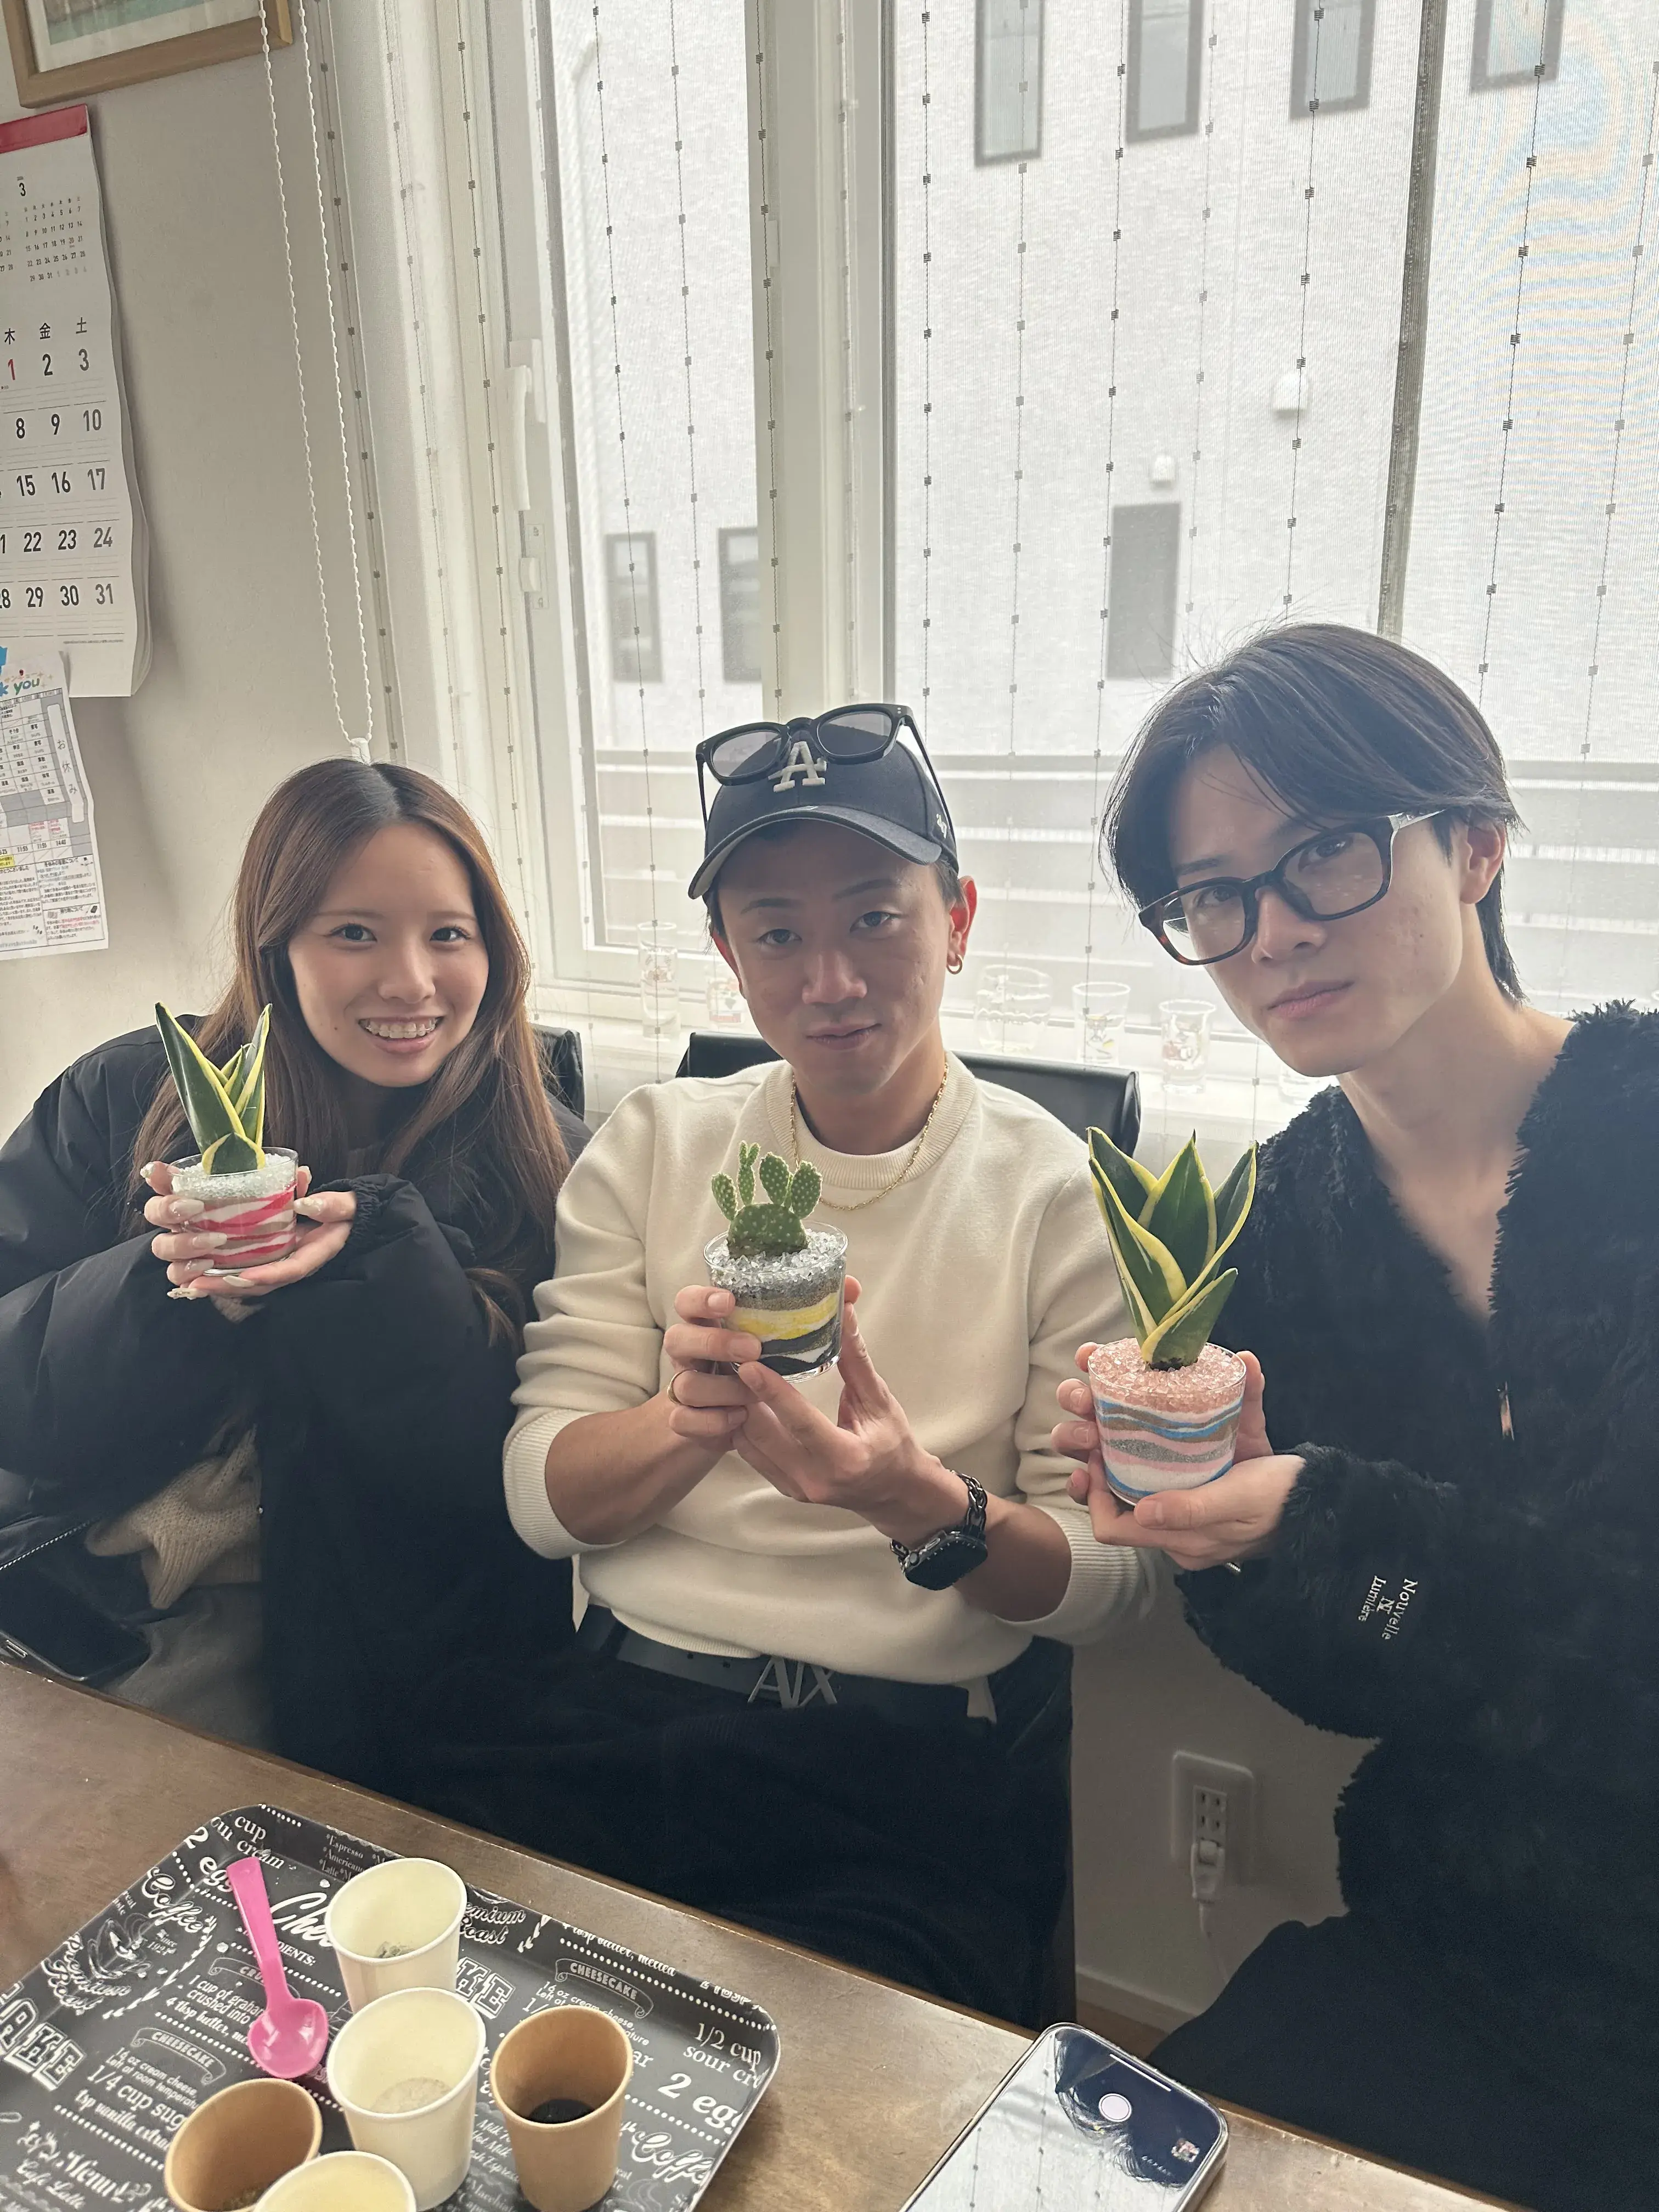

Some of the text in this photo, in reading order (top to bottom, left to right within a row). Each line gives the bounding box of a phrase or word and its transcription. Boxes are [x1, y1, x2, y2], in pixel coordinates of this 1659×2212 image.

[19, 183, 26, 196] 3
[4, 317, 87, 345] 木 金 土
[8, 349, 89, 380] 1 2 3
[16, 409, 101, 439] 8 9 10
[16, 468, 105, 496] 15 16 17
[0, 527, 113, 554] 1 22 23 24
[26, 587, 43, 607] 29
[60, 585, 80, 606] 30
[95, 584, 114, 605] 31
[14, 678, 40, 696] you
[1381, 1578, 1418, 1640] Nouvelle
[184, 1826, 209, 1849] 2
[234, 1816, 267, 1843] cup
[142, 1866, 204, 1933] Coffee
[465, 1902, 526, 1924] emium
[277, 1940, 317, 1966] DIENTS:
[188, 1974, 201, 1985] 1
[196, 1980, 218, 1994] cup
[216, 1989, 234, 2000] of
[543, 1981, 557, 1993] 16
[557, 1990, 571, 2000] oz
[569, 1962, 639, 2000] CHEESECAKE
[187, 1990, 251, 2024] crushed into
[522, 1997, 550, 2014] 1/
[535, 1988, 567, 2006] Left at
[151, 2031, 215, 2068] CHEESECAKE
[625, 2029, 650, 2046] ature
[695, 2022, 761, 2073] 1/2 cup
[683, 2045, 730, 2073] sour
[122, 2064, 134, 2073] at
[132, 2071, 156, 2087] room
[155, 2082, 200, 2109] temperatu
[127, 2056, 140, 2066] oz
[139, 2062, 167, 2080] cream
[167, 2075, 198, 2098] cheese,
[657, 2073, 692, 2099] 2
[87, 2064, 188, 2132] 1/4 cup sug
[94, 2102, 137, 2131] vanilla
